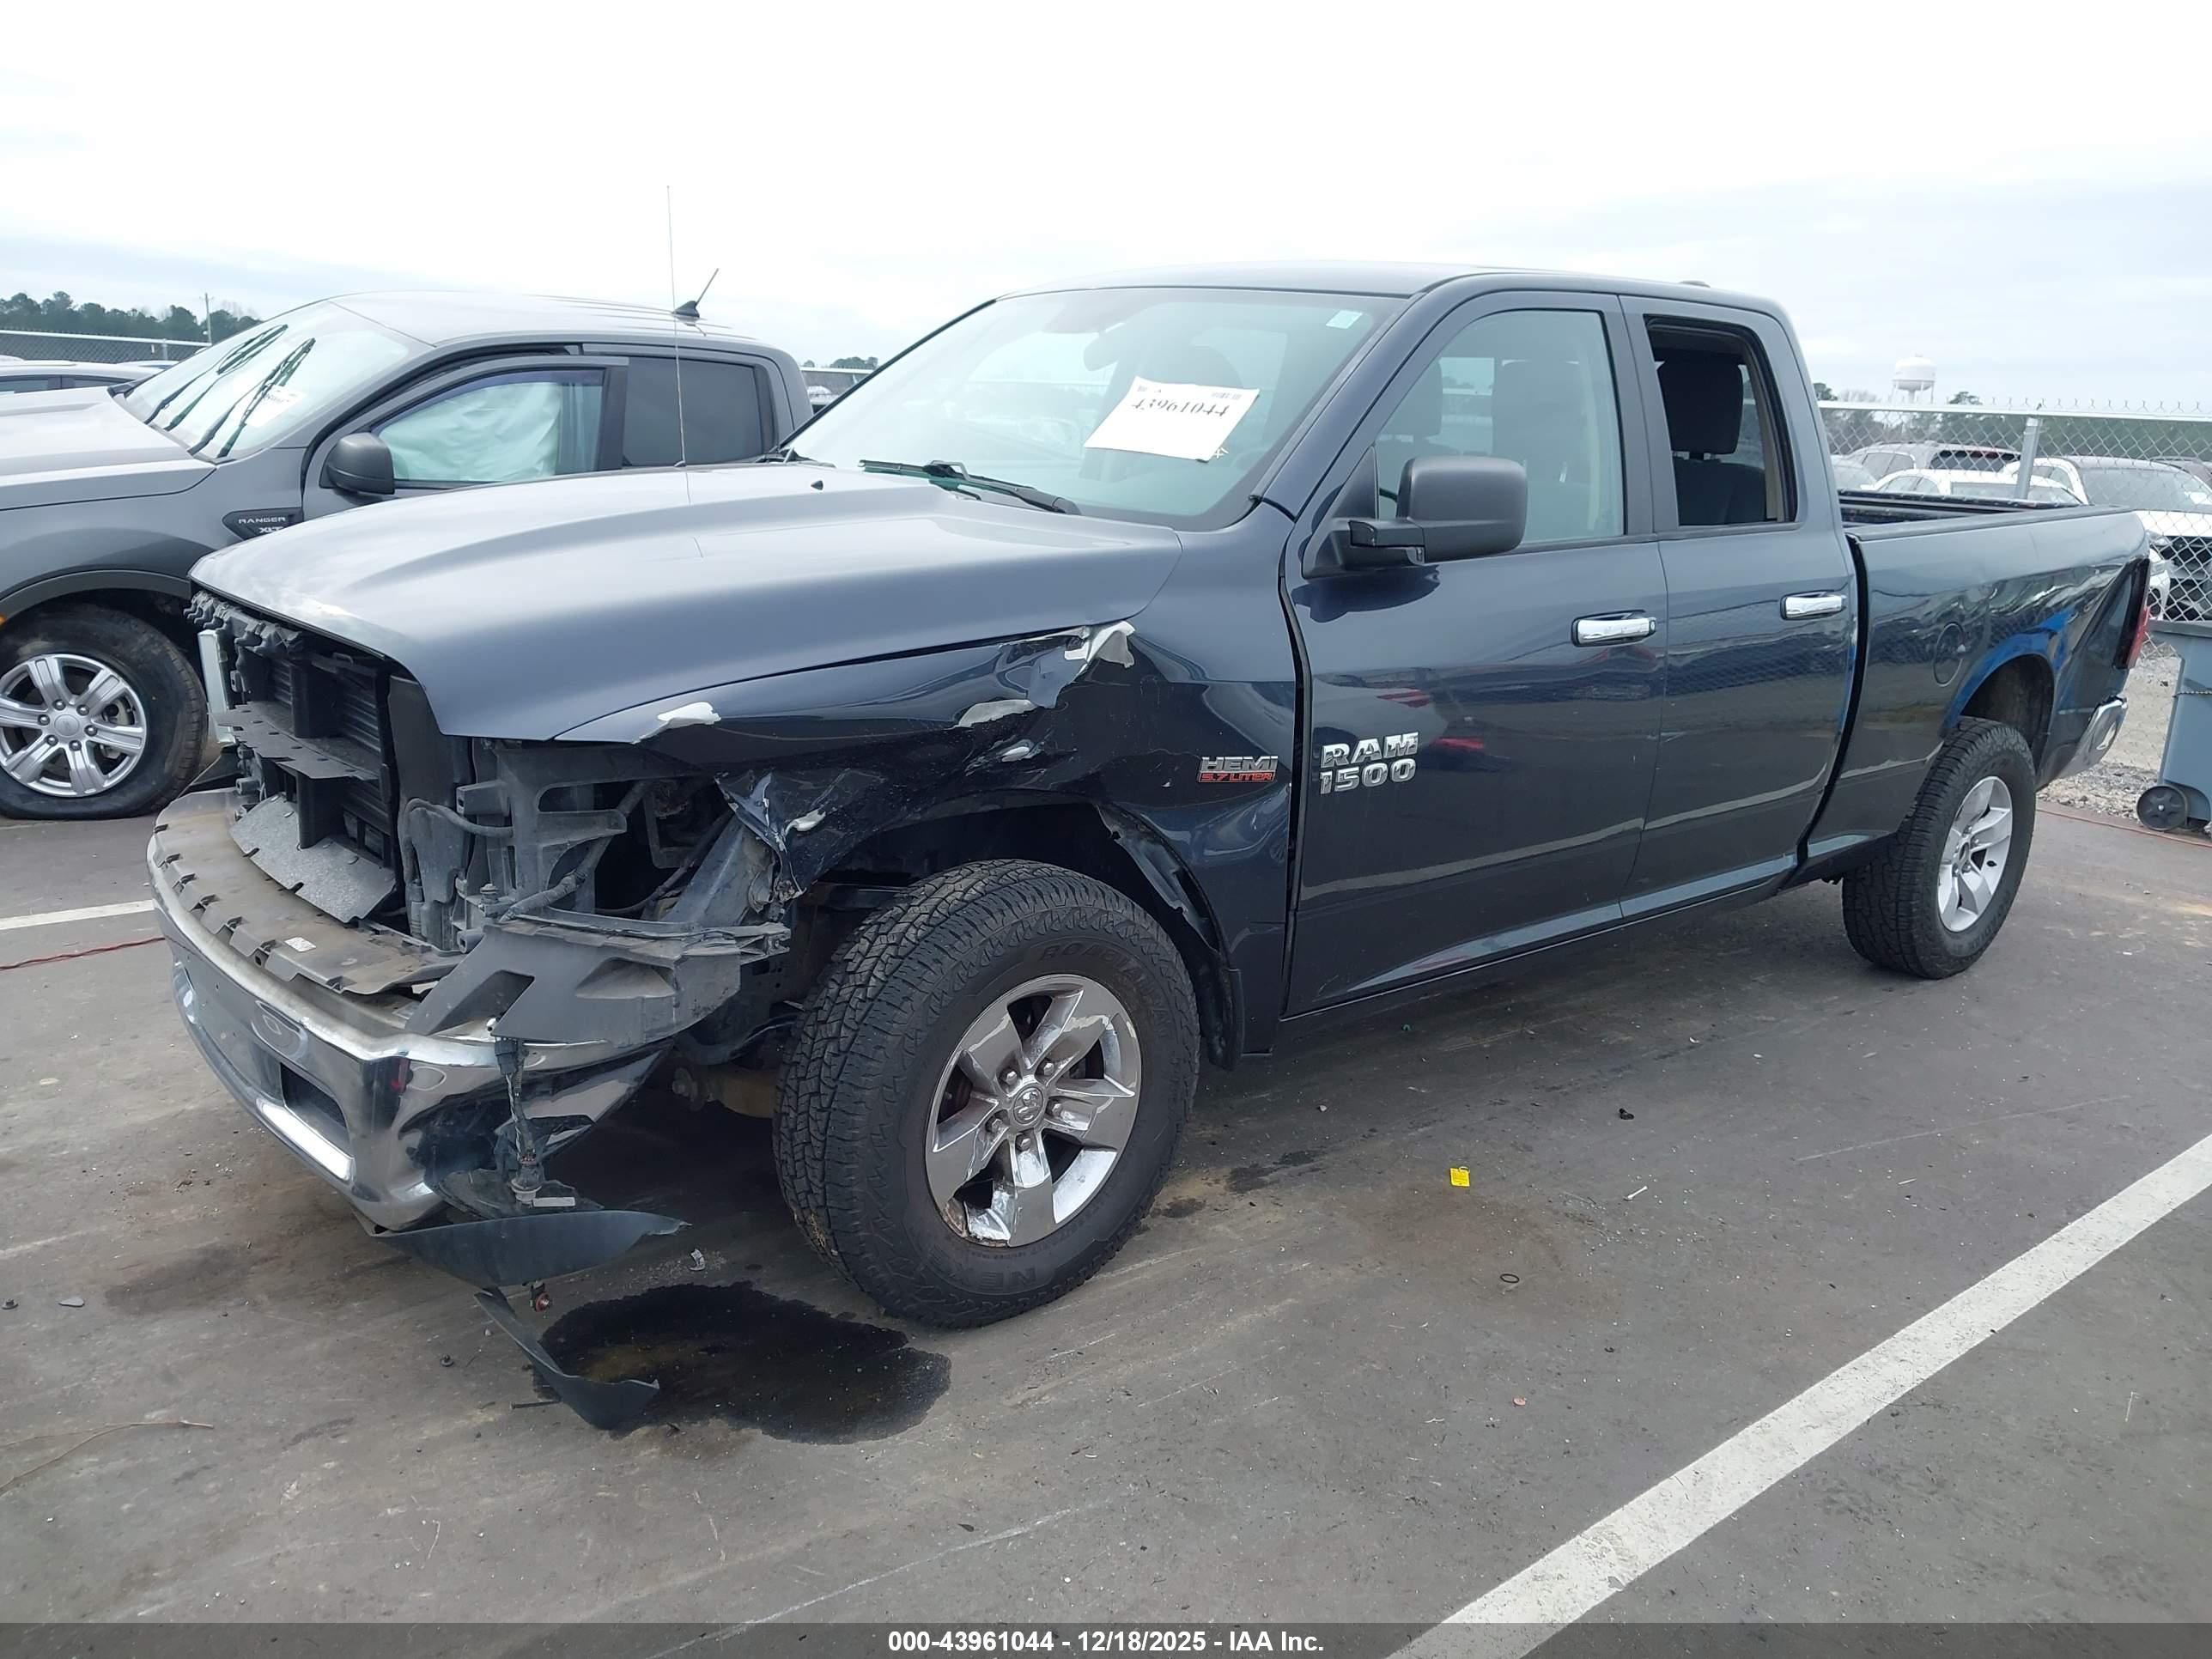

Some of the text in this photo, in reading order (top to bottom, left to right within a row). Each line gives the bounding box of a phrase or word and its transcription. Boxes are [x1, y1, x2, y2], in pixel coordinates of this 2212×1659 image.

[1132, 398, 1230, 416] 43961044
[238, 516, 286, 525] RANGER
[1320, 732, 1419, 769] RAM
[1200, 756, 1279, 772] HEMI
[1200, 773, 1273, 781] 5.7 LITER
[1320, 757, 1416, 795] 1500
